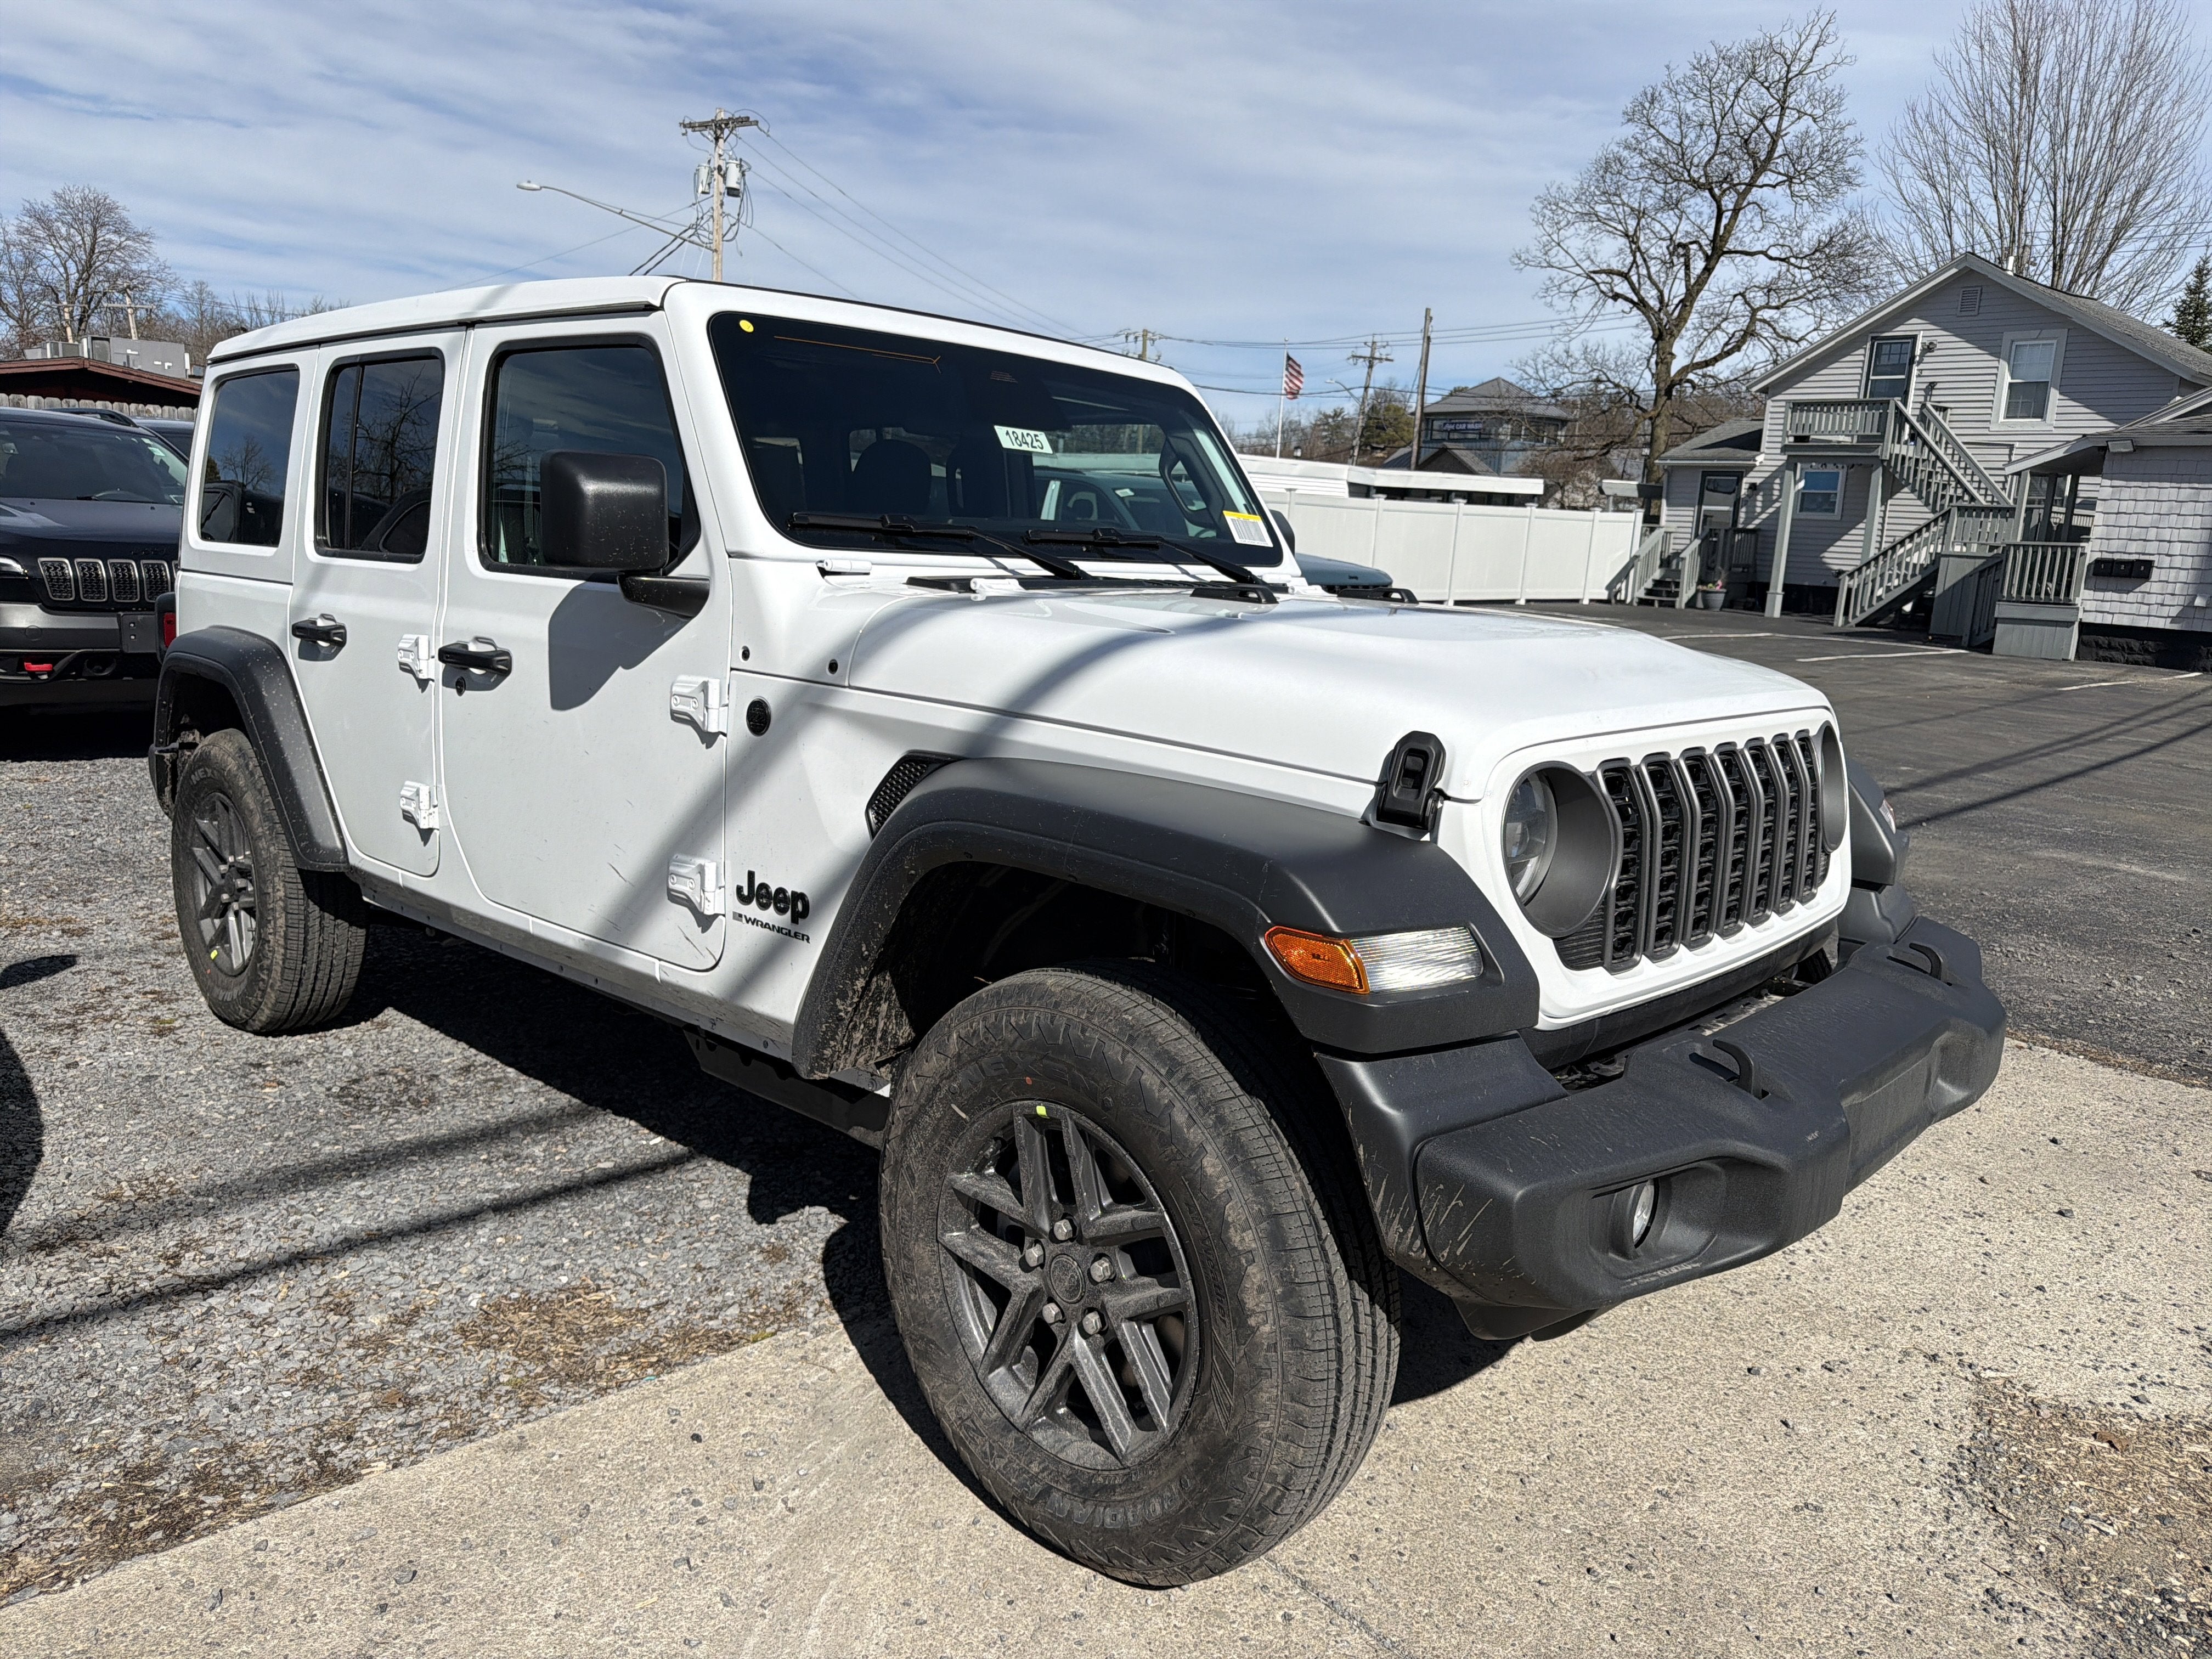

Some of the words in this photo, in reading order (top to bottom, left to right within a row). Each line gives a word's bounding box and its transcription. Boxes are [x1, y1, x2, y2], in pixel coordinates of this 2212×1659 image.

[1005, 430, 1044, 450] 18425
[736, 870, 810, 926] Jeep
[743, 914, 811, 944] WRANGLER
[960, 1053, 1100, 1104] NEXEN
[1045, 1483, 1181, 1529] ROADIAN
